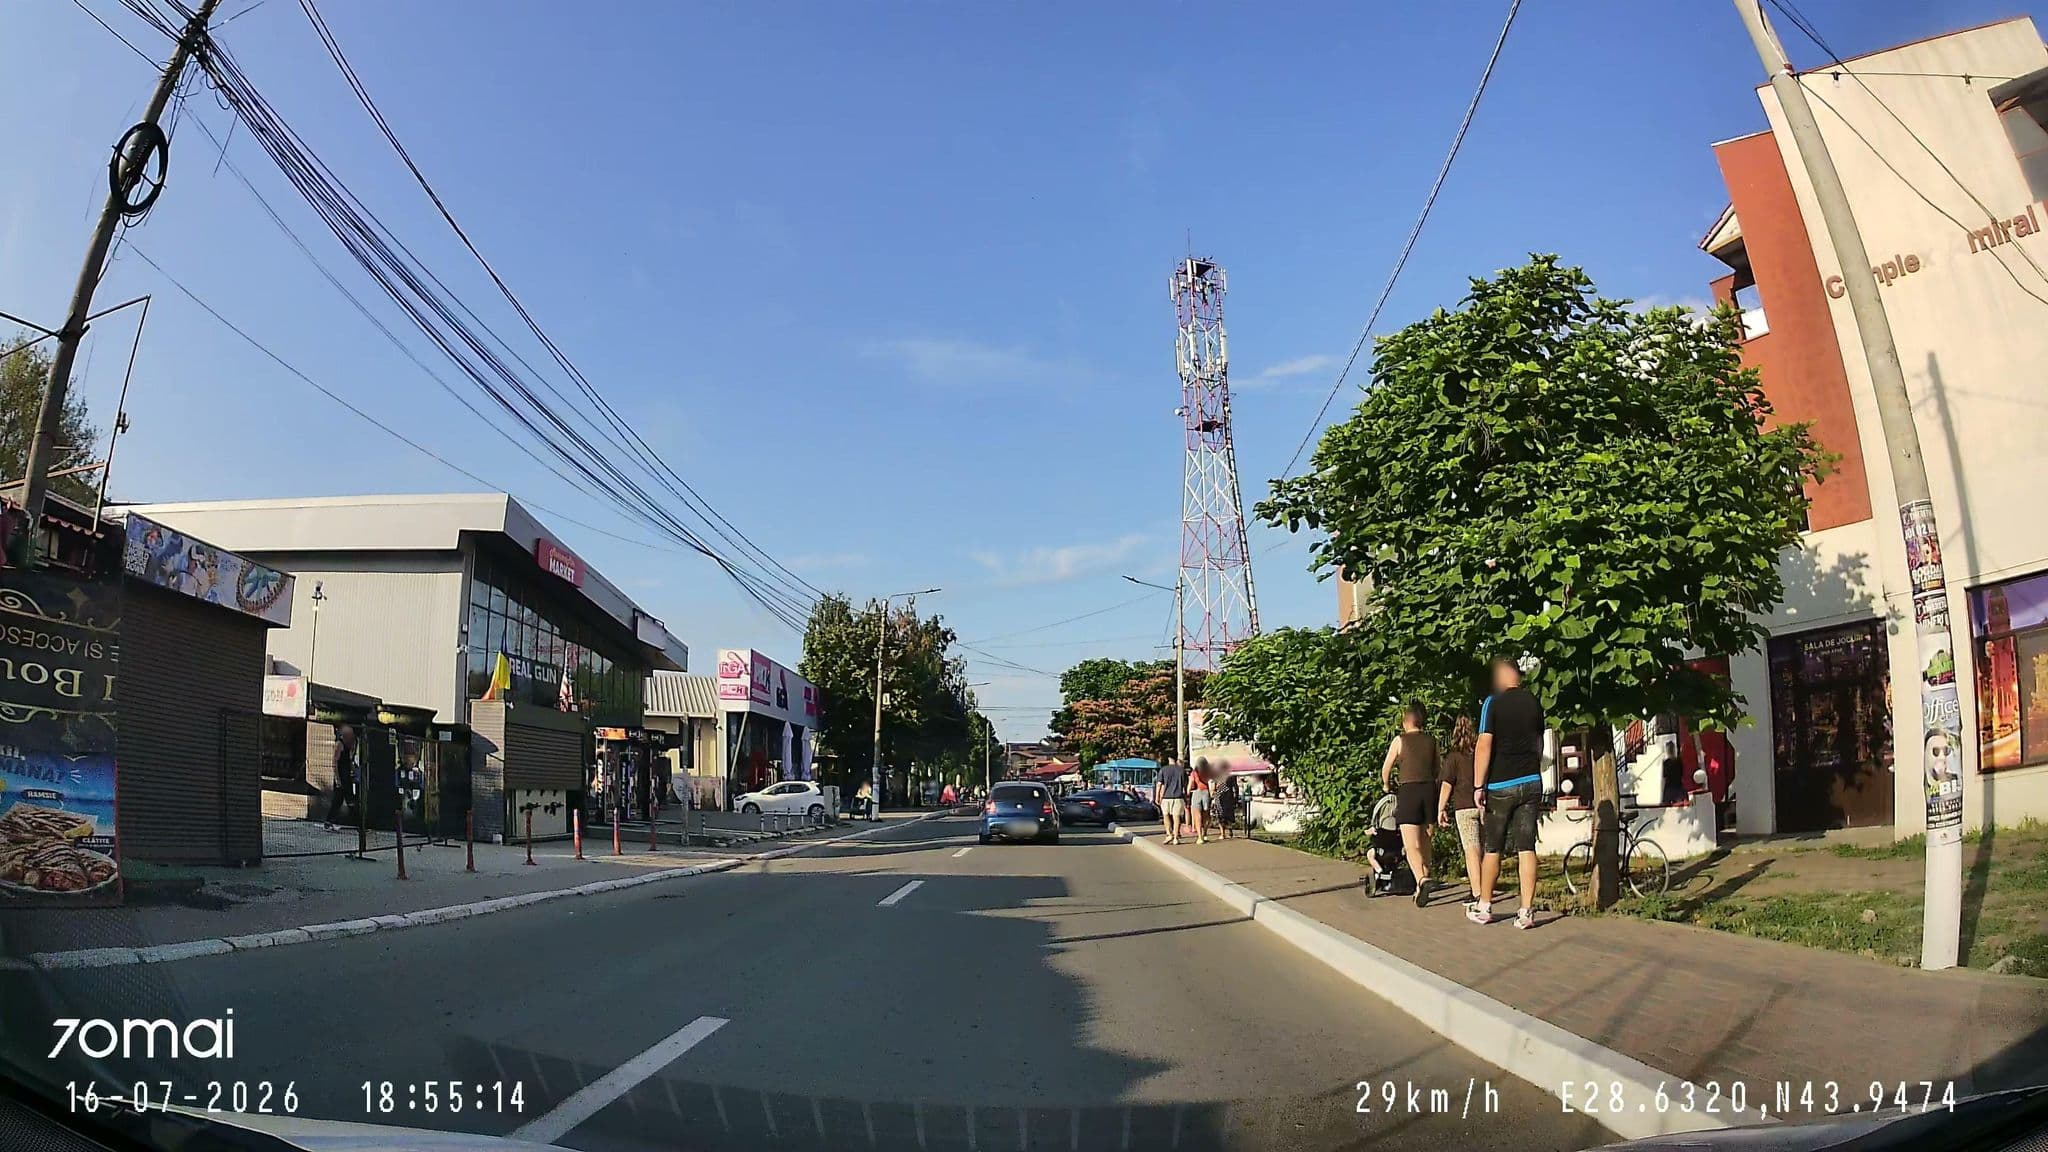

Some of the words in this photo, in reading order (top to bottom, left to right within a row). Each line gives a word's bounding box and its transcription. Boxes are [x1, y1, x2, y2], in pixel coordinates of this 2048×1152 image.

[1966, 205, 2040, 254] miral
[549, 557, 575, 583] MARKET
[1804, 641, 1824, 651] SALA
[1825, 638, 1836, 648] DE
[508, 657, 532, 679] REAL
[534, 664, 557, 684] GUN
